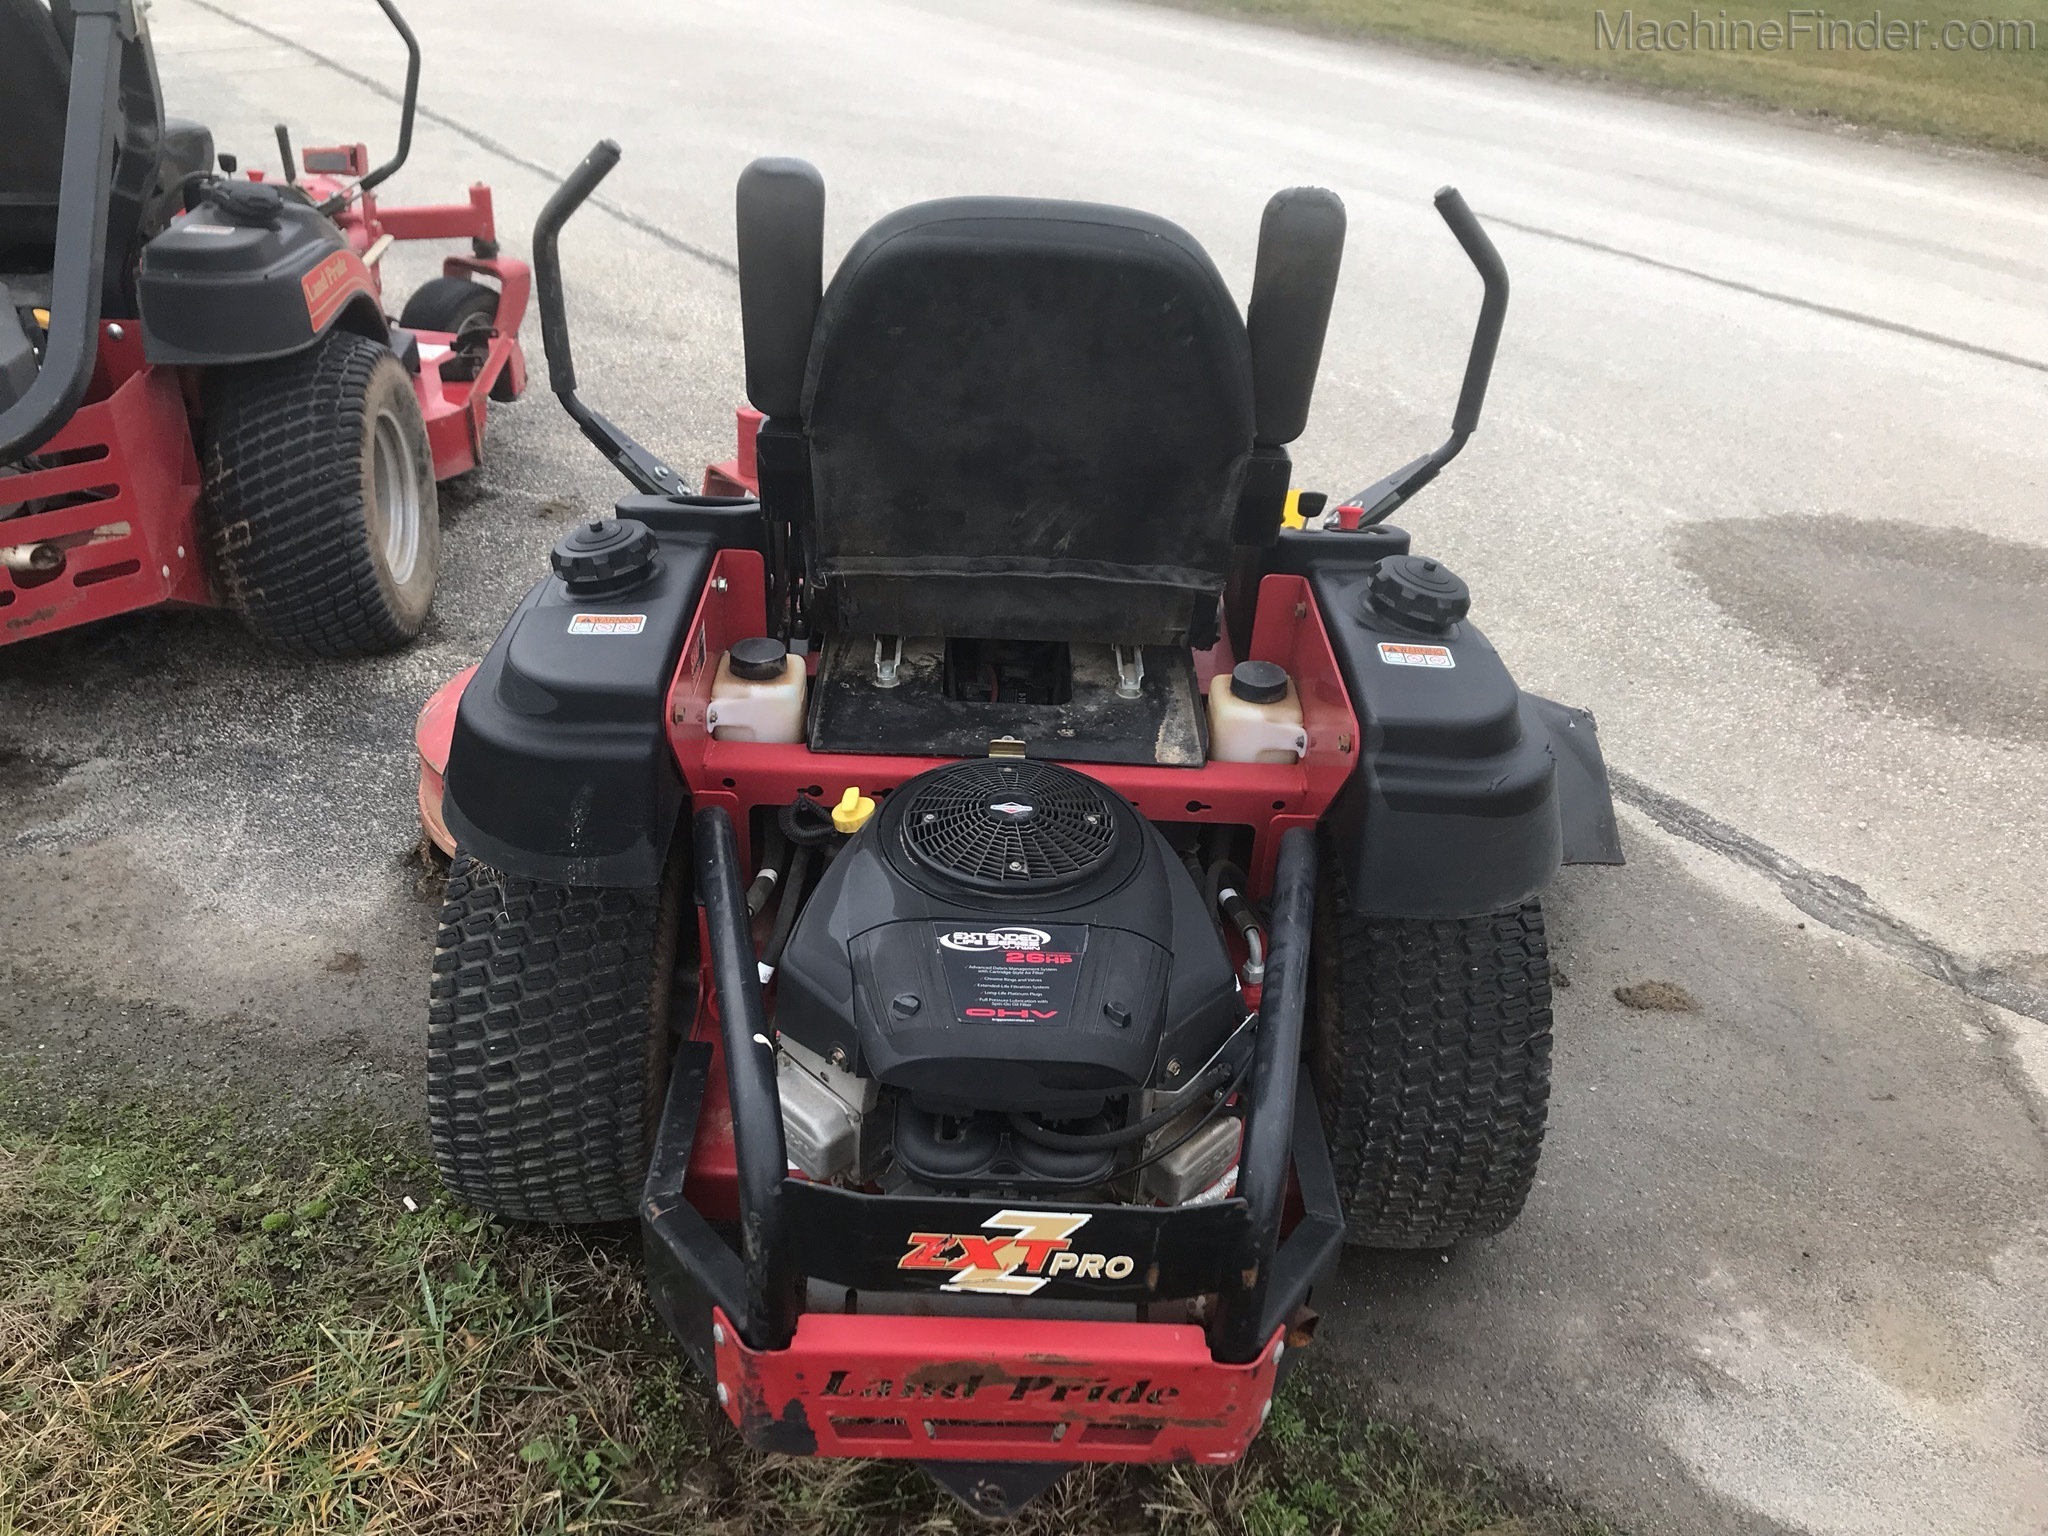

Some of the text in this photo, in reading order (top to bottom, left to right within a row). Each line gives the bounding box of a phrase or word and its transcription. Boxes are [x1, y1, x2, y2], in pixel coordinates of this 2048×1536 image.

[953, 932, 1040, 941] EXTENDED
[966, 1008, 1058, 1019] OHV
[897, 1232, 1134, 1279] ZXT PRO
[820, 1369, 1180, 1406] Land Pride
